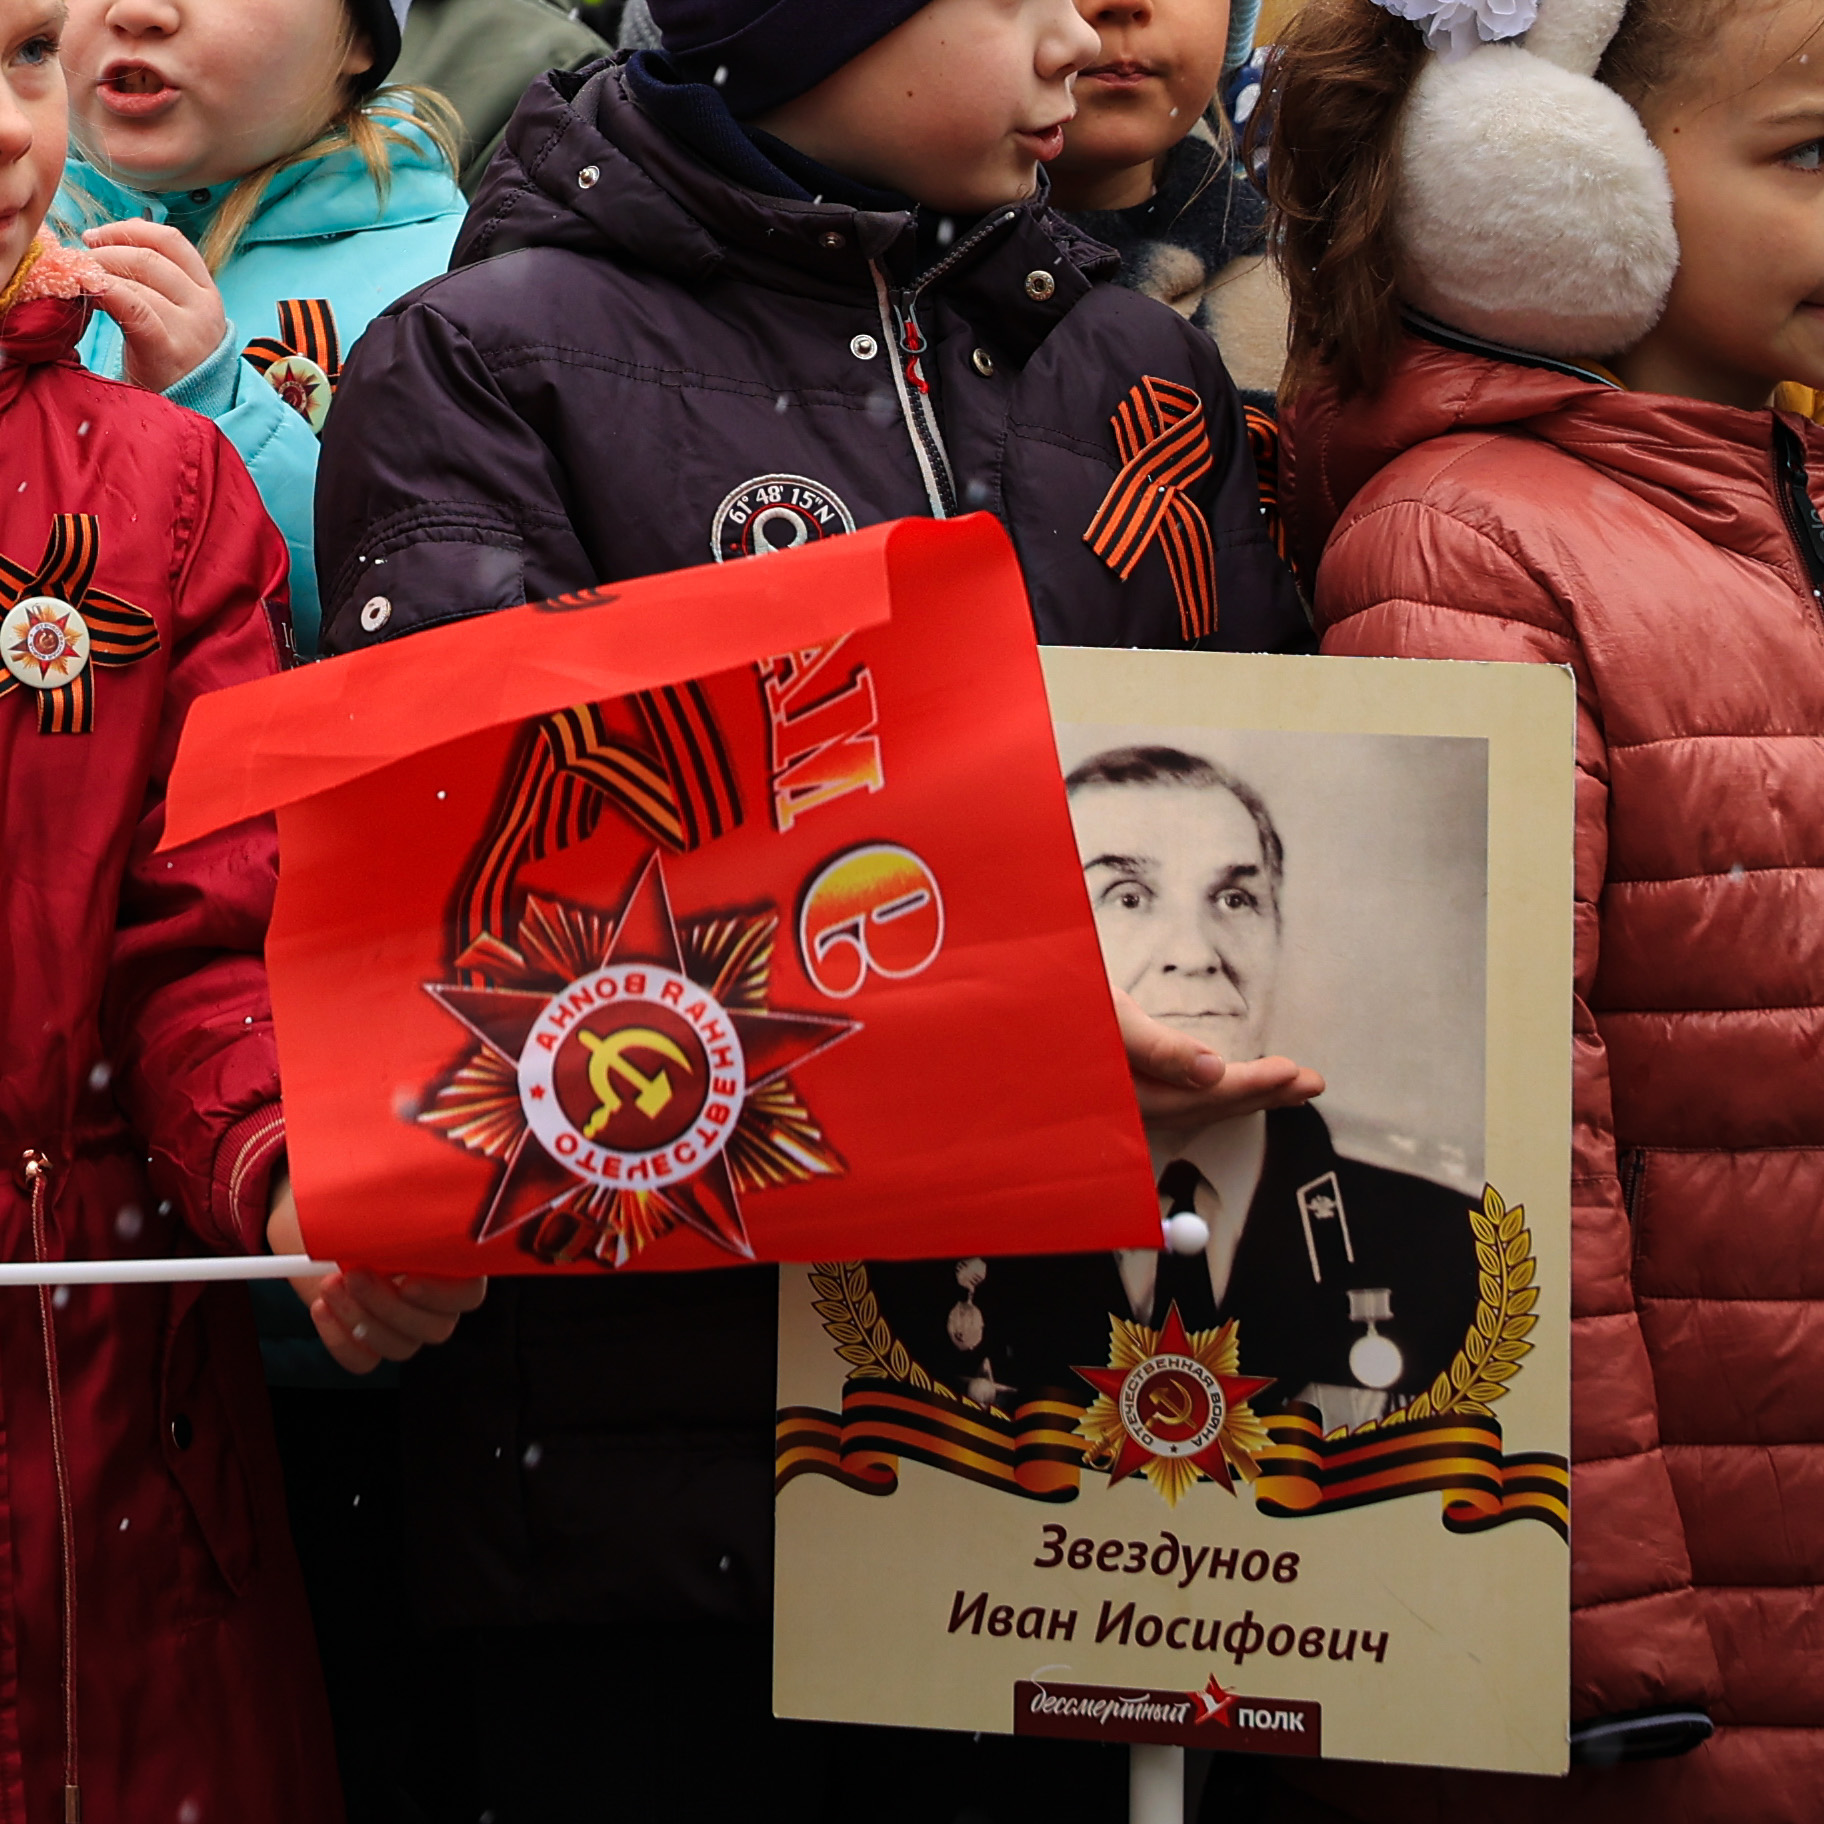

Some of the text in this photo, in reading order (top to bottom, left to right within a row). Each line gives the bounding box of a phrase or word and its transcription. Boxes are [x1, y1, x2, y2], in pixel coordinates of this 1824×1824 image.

[729, 496, 752, 525] 61°
[755, 485, 784, 505] 48'
[1124, 1354, 1217, 1448] ОТЕЧЕСТВЕННАЯ
[1033, 1522, 1301, 1588] Звездунов
[946, 1588, 1390, 1666] Иван Иосифович
[1029, 1669, 1306, 1733] бессмертный ПОЛК
